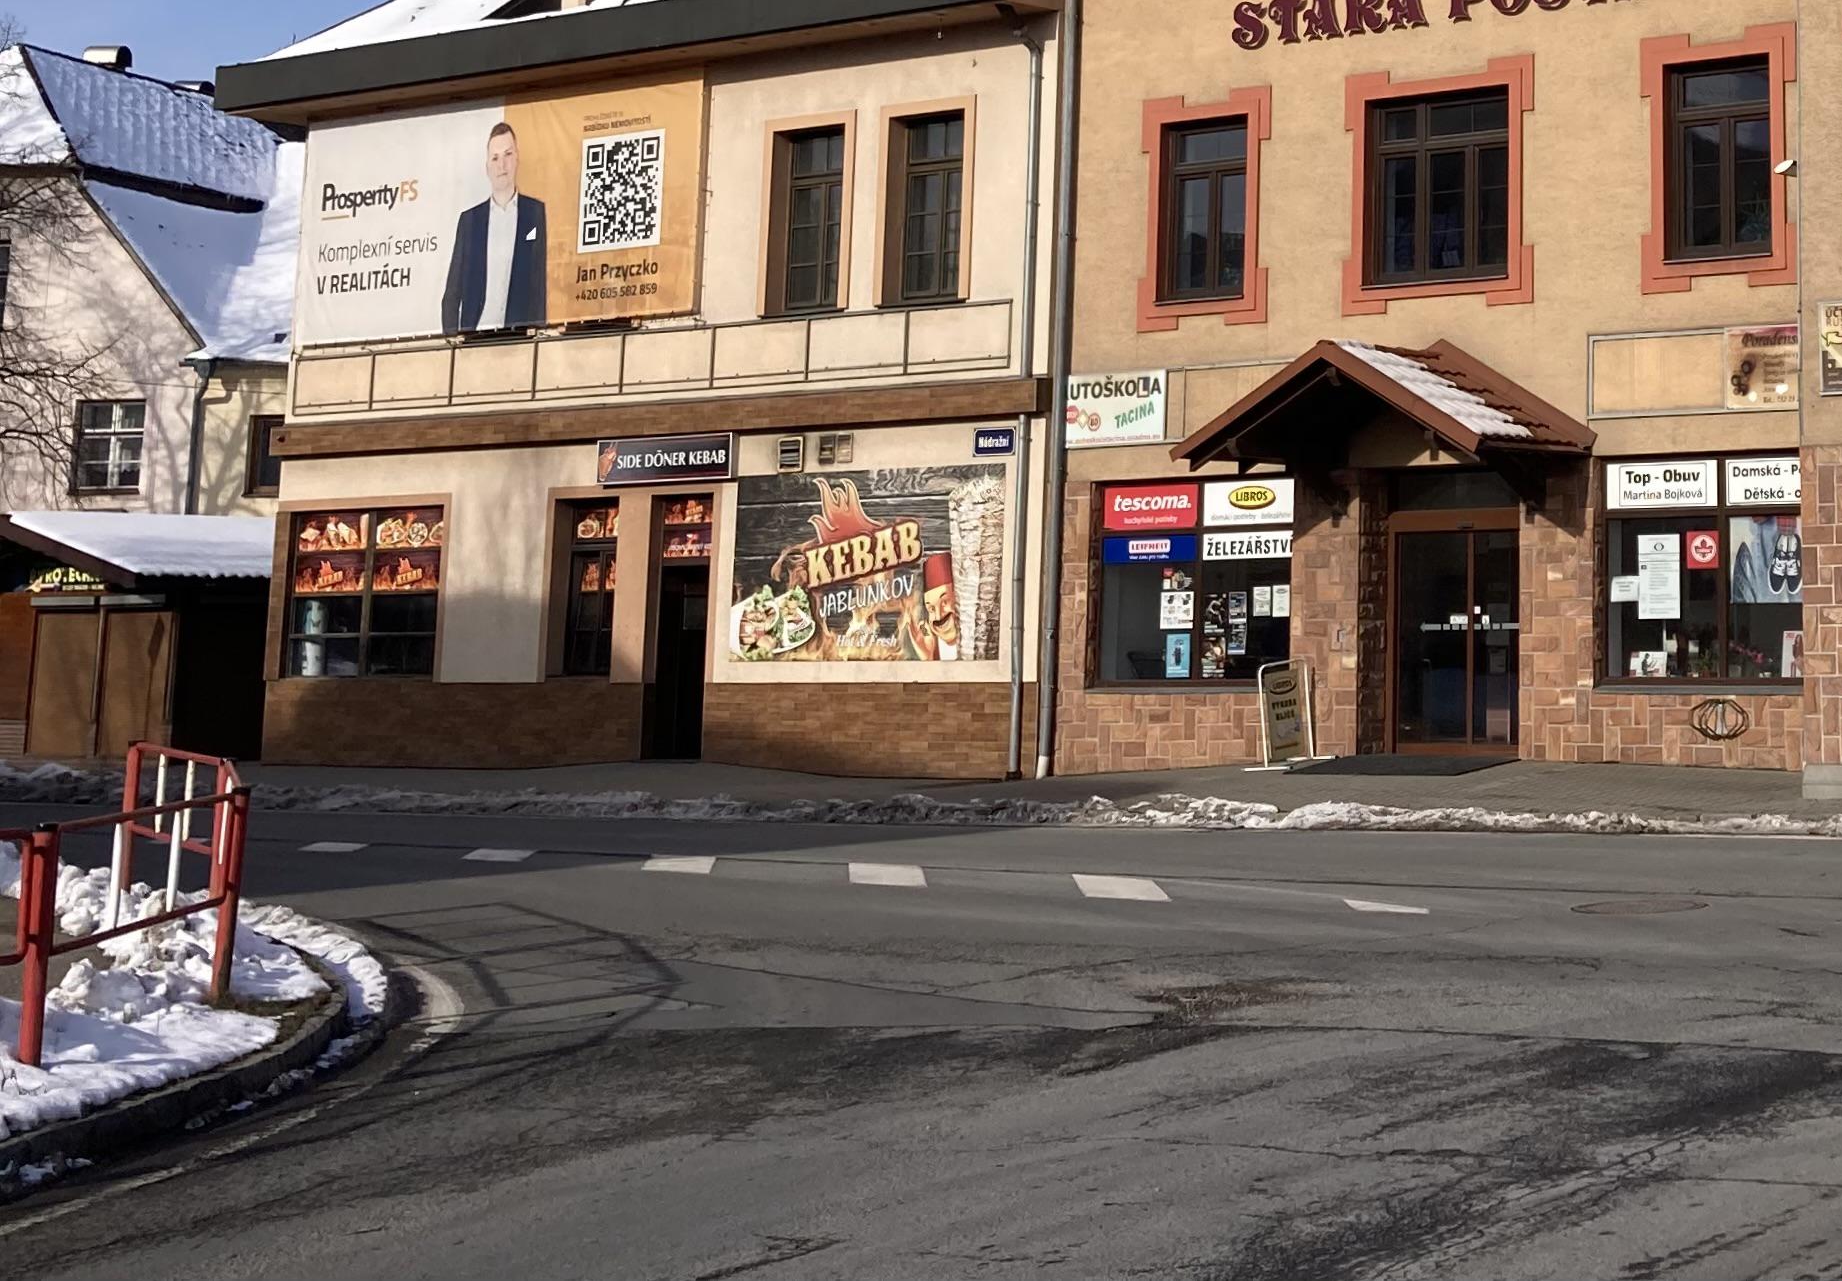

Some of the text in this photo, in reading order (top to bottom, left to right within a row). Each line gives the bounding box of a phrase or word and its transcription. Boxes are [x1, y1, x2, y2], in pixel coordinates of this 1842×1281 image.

[318, 233, 438, 265] Komplexní servis
[317, 264, 411, 295] V REALITÁCH
[576, 259, 658, 283] Jan Przyczko
[576, 289, 598, 301] +420
[640, 283, 657, 295] 859
[1742, 330, 1798, 348] Poradens
[1069, 375, 1162, 400] UTOŠKOLA
[978, 435, 1010, 448] Nádražní
[617, 449, 726, 469] SIDE DÖNER KEBAB
[1625, 471, 1650, 486] Top
[1663, 469, 1700, 484] Obuv
[1236, 491, 1268, 502] LIBROS
[1623, 487, 1703, 501] Martina Bojková
[1744, 486, 1784, 500] Dětská
[805, 520, 922, 588] KEBAB
[1131, 542, 1169, 551] LEIFHEIT
[819, 574, 915, 618] JABLUNKOV
[869, 632, 898, 647] Fresh
